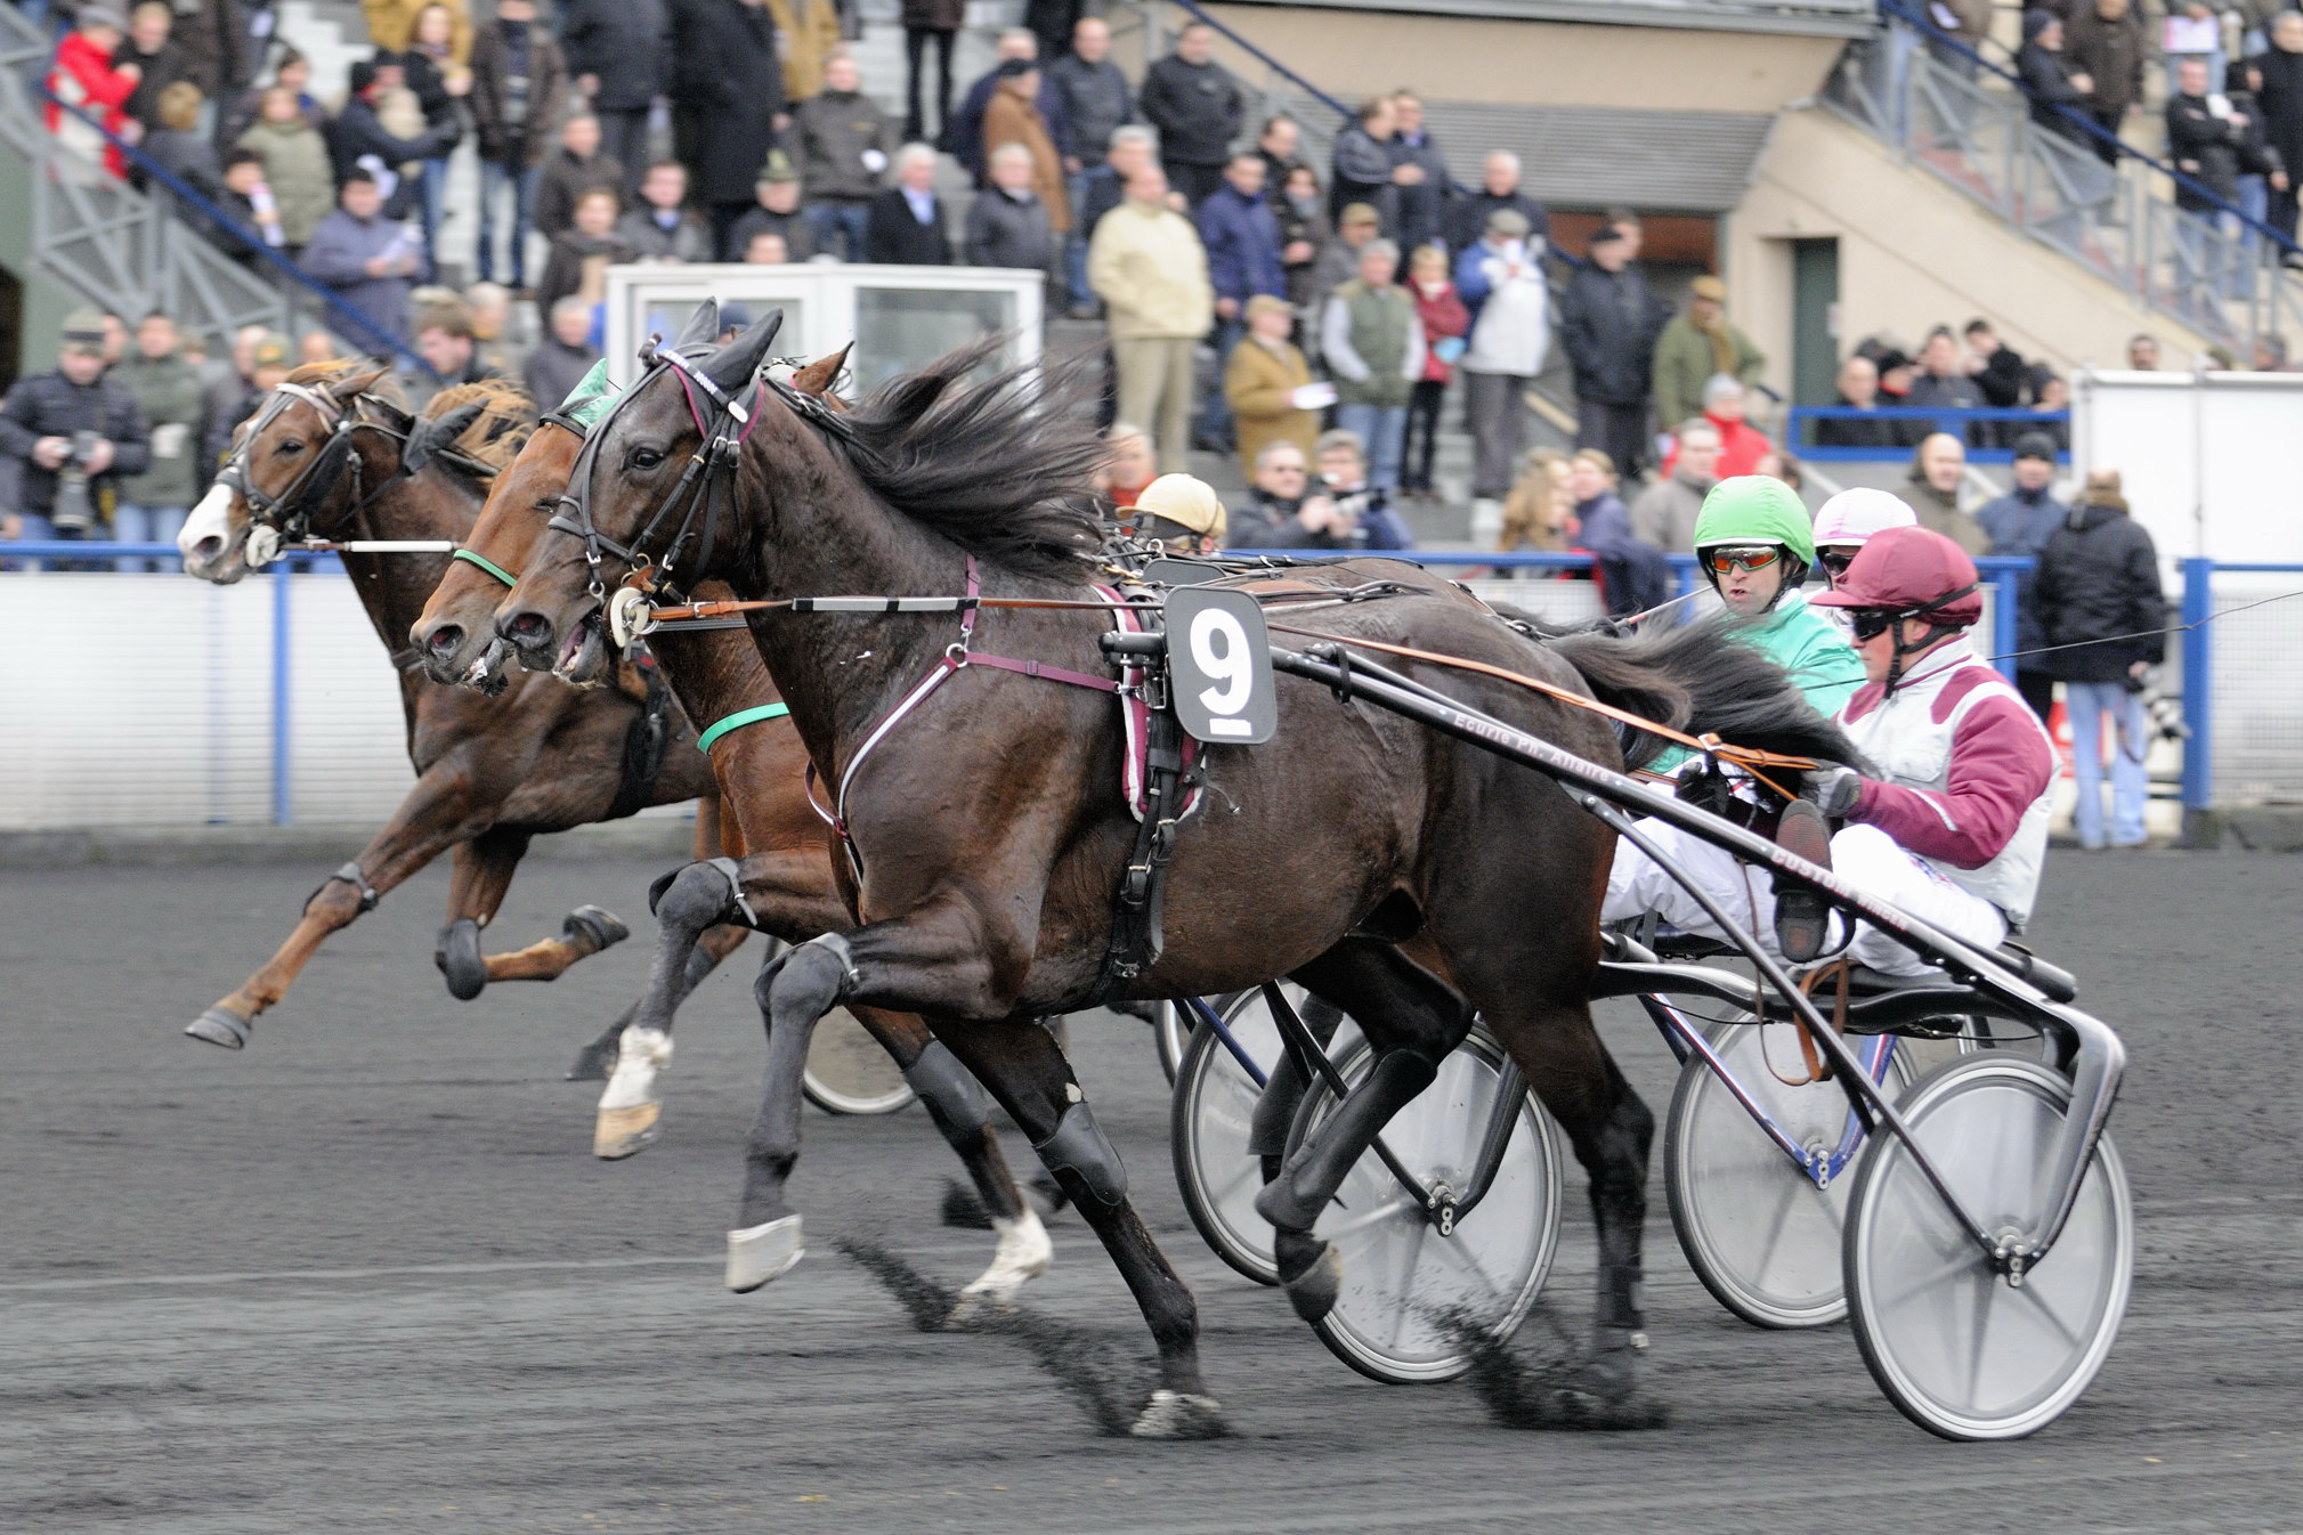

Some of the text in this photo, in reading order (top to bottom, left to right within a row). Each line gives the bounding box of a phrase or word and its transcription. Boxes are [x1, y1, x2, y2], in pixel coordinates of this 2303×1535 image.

[1190, 608, 1252, 716] 9
[1453, 712, 1510, 744] Ecurie
[1516, 737, 1544, 758] Ph.
